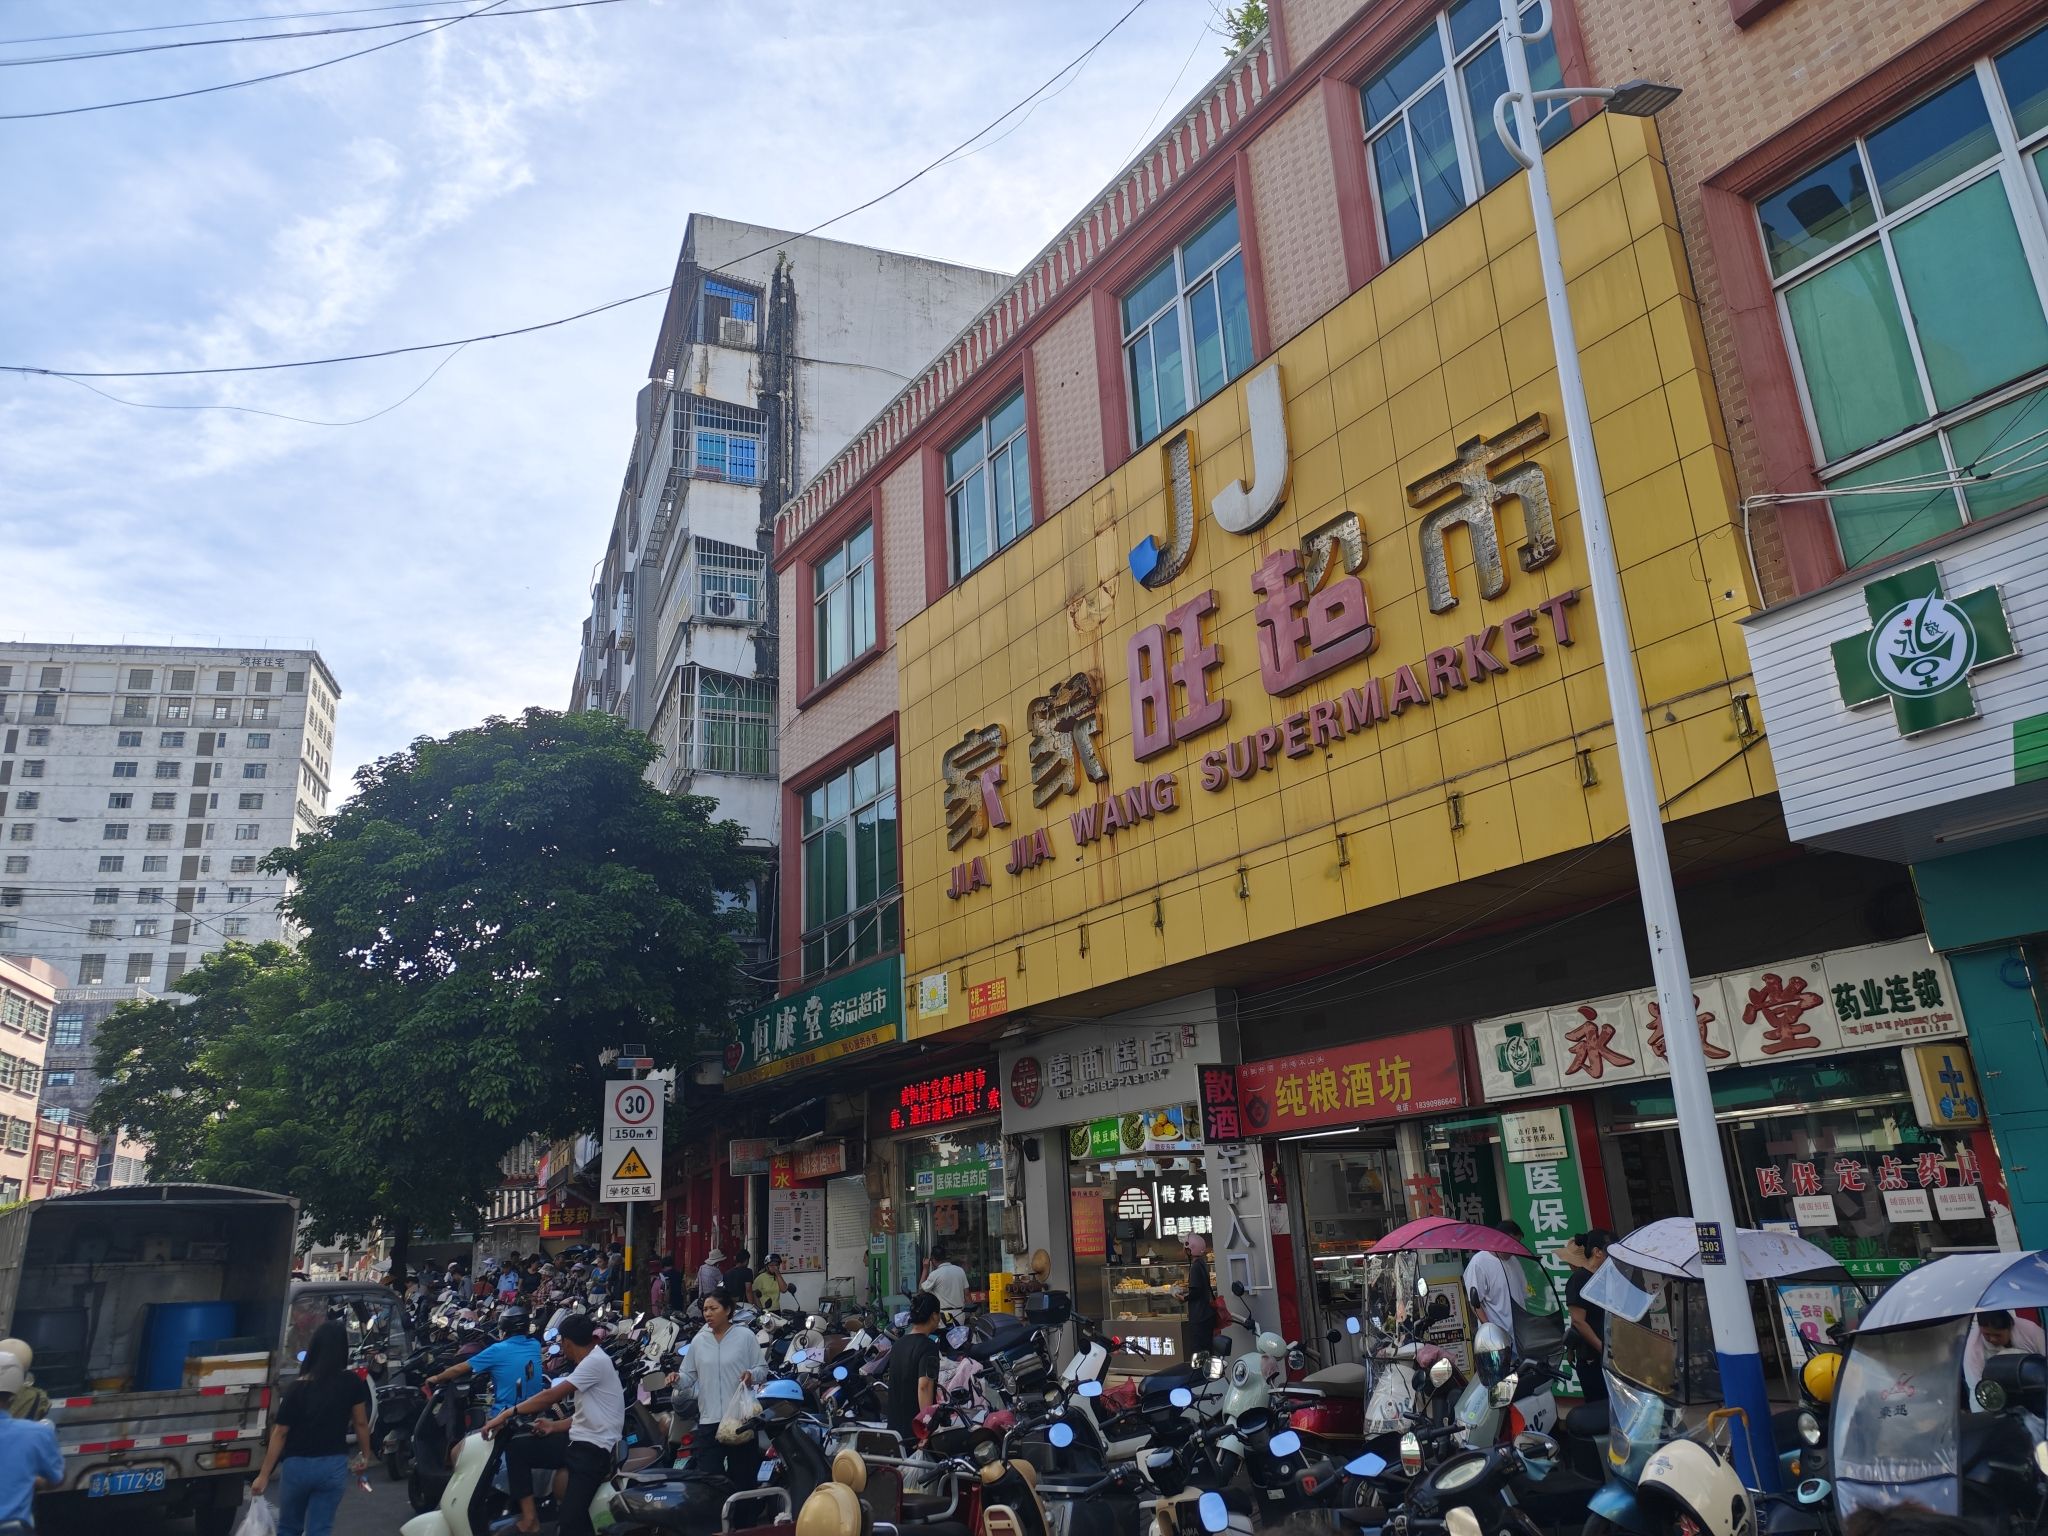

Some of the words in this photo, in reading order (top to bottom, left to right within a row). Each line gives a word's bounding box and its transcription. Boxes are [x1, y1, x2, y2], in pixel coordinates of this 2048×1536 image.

[942, 411, 1563, 852] 家家旺超市
[240, 656, 285, 667] 鸿祥住宅
[946, 857, 991, 901] JIA
[1005, 827, 1056, 876] JIA
[1070, 771, 1180, 847] WANG
[1200, 588, 1581, 793] SUPERMARKET
[1831, 968, 1944, 1021] 药业连锁
[750, 995, 824, 1063] 恒康堂
[829, 986, 887, 1029] 药品超市
[1083, 1079, 1116, 1095] CRISP
[1118, 1069, 1164, 1088] PASTRY
[1274, 1055, 1412, 1118] 纯粮酒坊
[625, 1096, 645, 1114] 30
[1203, 1070, 1241, 1140] 散酒
[615, 1129, 644, 1139] 150m
[1518, 1125, 1545, 1135] 医疗保障
[936, 1168, 987, 1190] 医保定点药店
[1756, 1149, 1982, 1198] 医保定点药店
[609, 1186, 652, 1196] 学校区域
[1161, 1184, 1209, 1203] 传承古
[1703, 1241, 1719, 1252] 303
[1840, 1261, 1885, 1273] 业连锁
